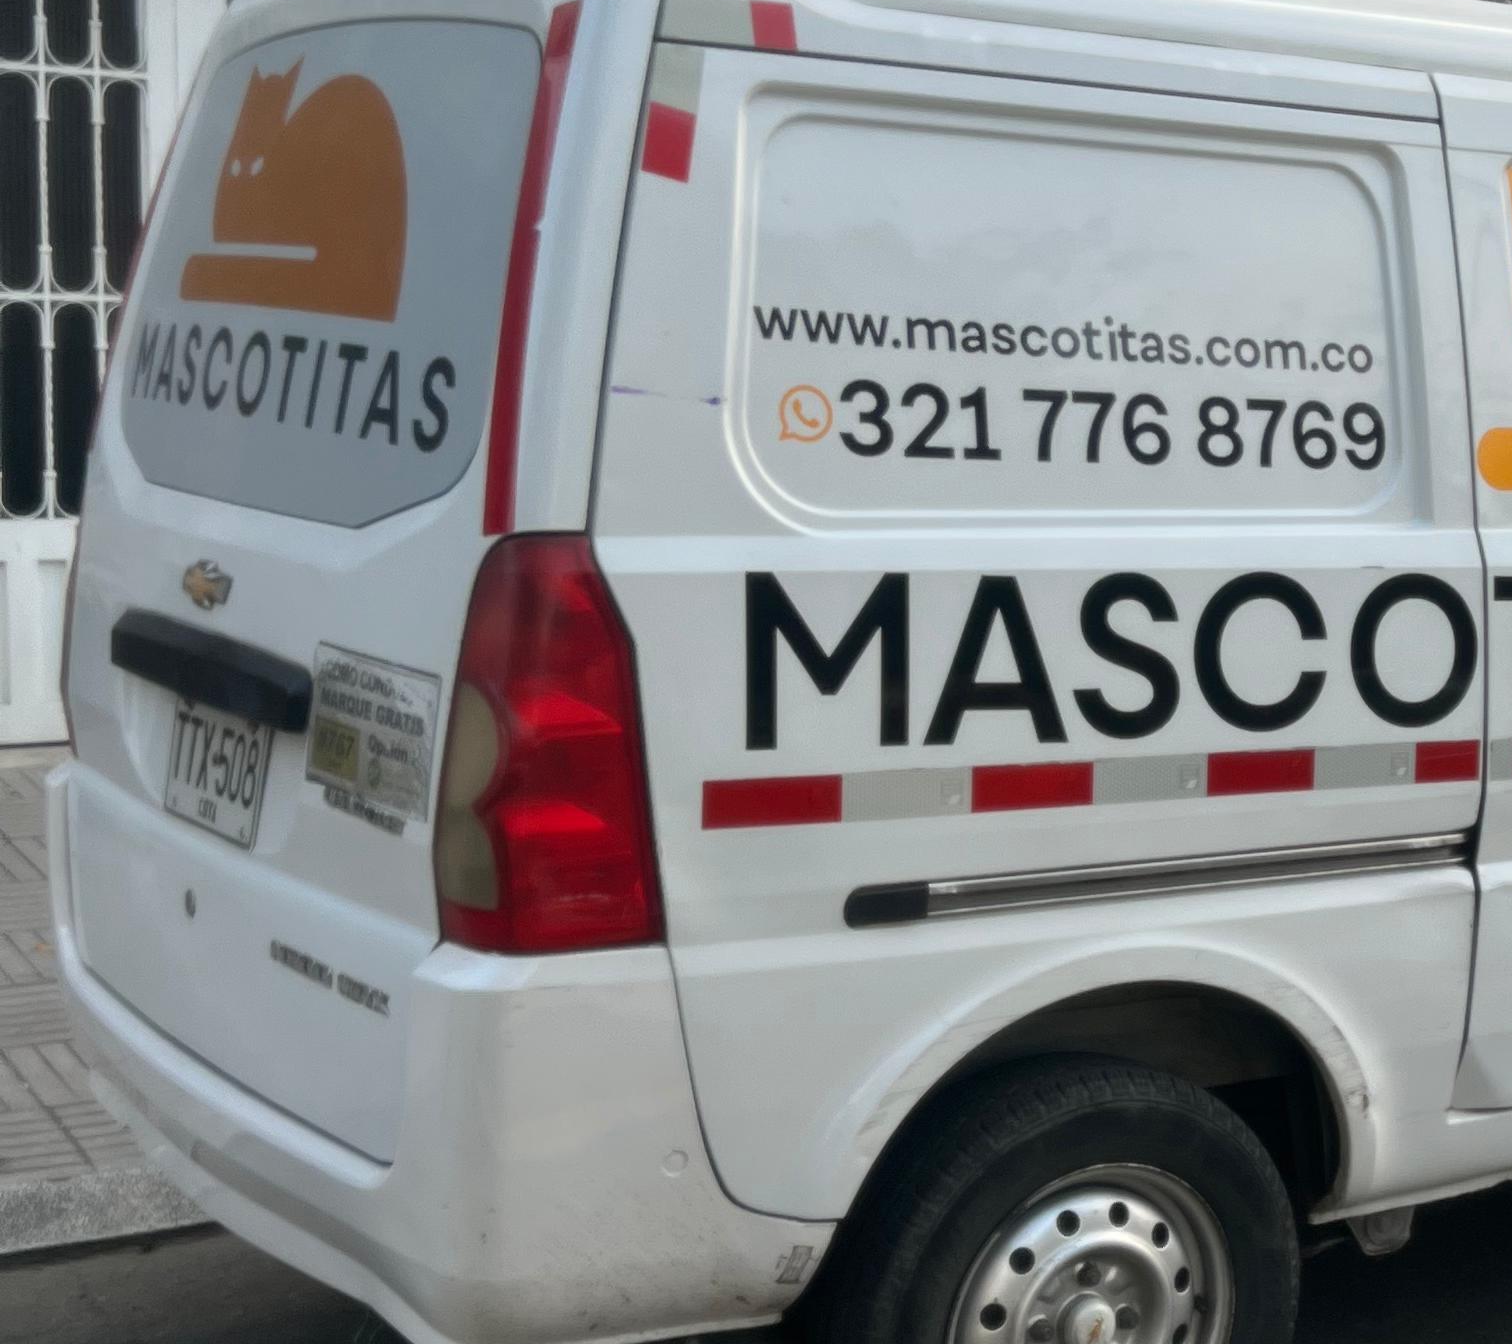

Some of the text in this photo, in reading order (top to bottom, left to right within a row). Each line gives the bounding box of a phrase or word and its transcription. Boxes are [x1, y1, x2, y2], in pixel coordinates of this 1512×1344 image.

[752, 304, 1374, 374] www.mascotitas.com.co
[131, 322, 456, 454] MASCOTITAS
[838, 378, 1387, 471] 321 776 8769
